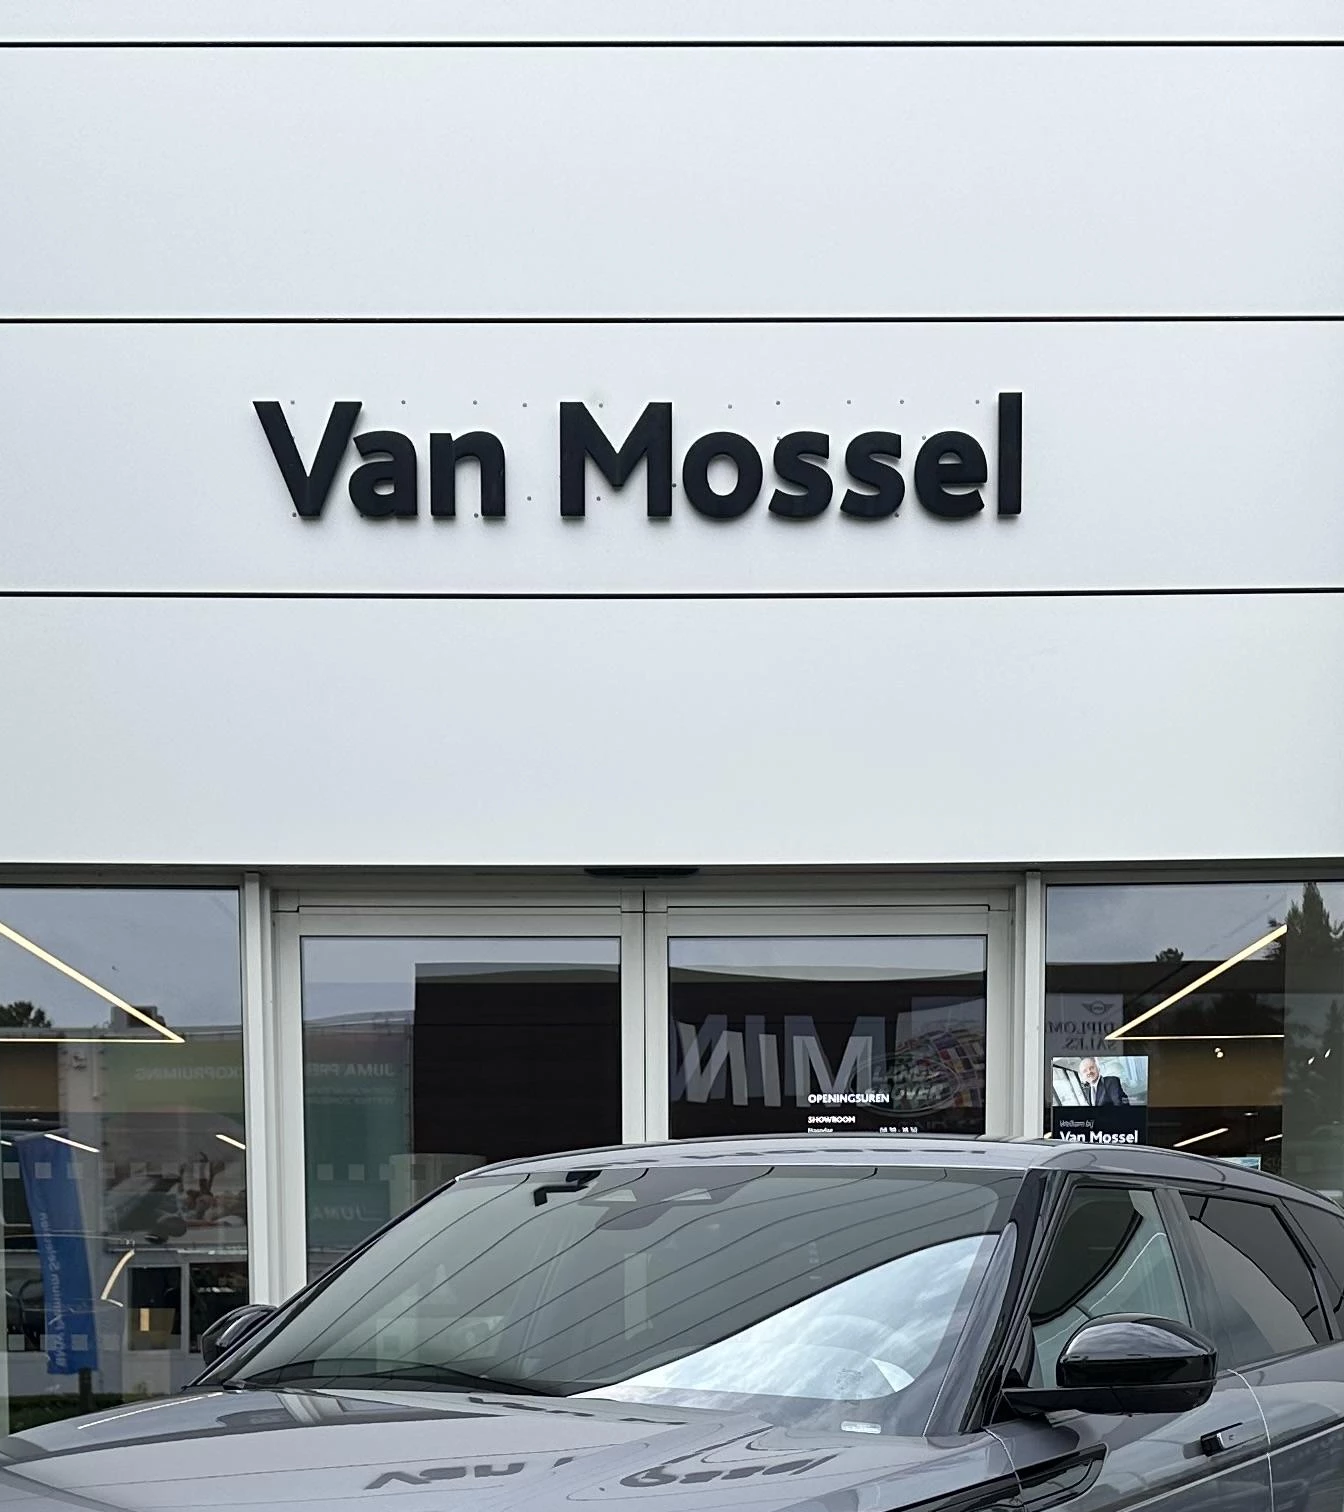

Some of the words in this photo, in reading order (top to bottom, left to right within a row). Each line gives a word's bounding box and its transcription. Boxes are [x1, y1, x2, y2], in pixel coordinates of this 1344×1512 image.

[253, 400, 506, 519] Van
[559, 391, 1023, 520] Mossel
[807, 1093, 890, 1104] OPENINGSUREN
[807, 1115, 856, 1124] SHOWROOM
[1059, 1130, 1086, 1142] Van
[1089, 1129, 1140, 1144] Mossel
